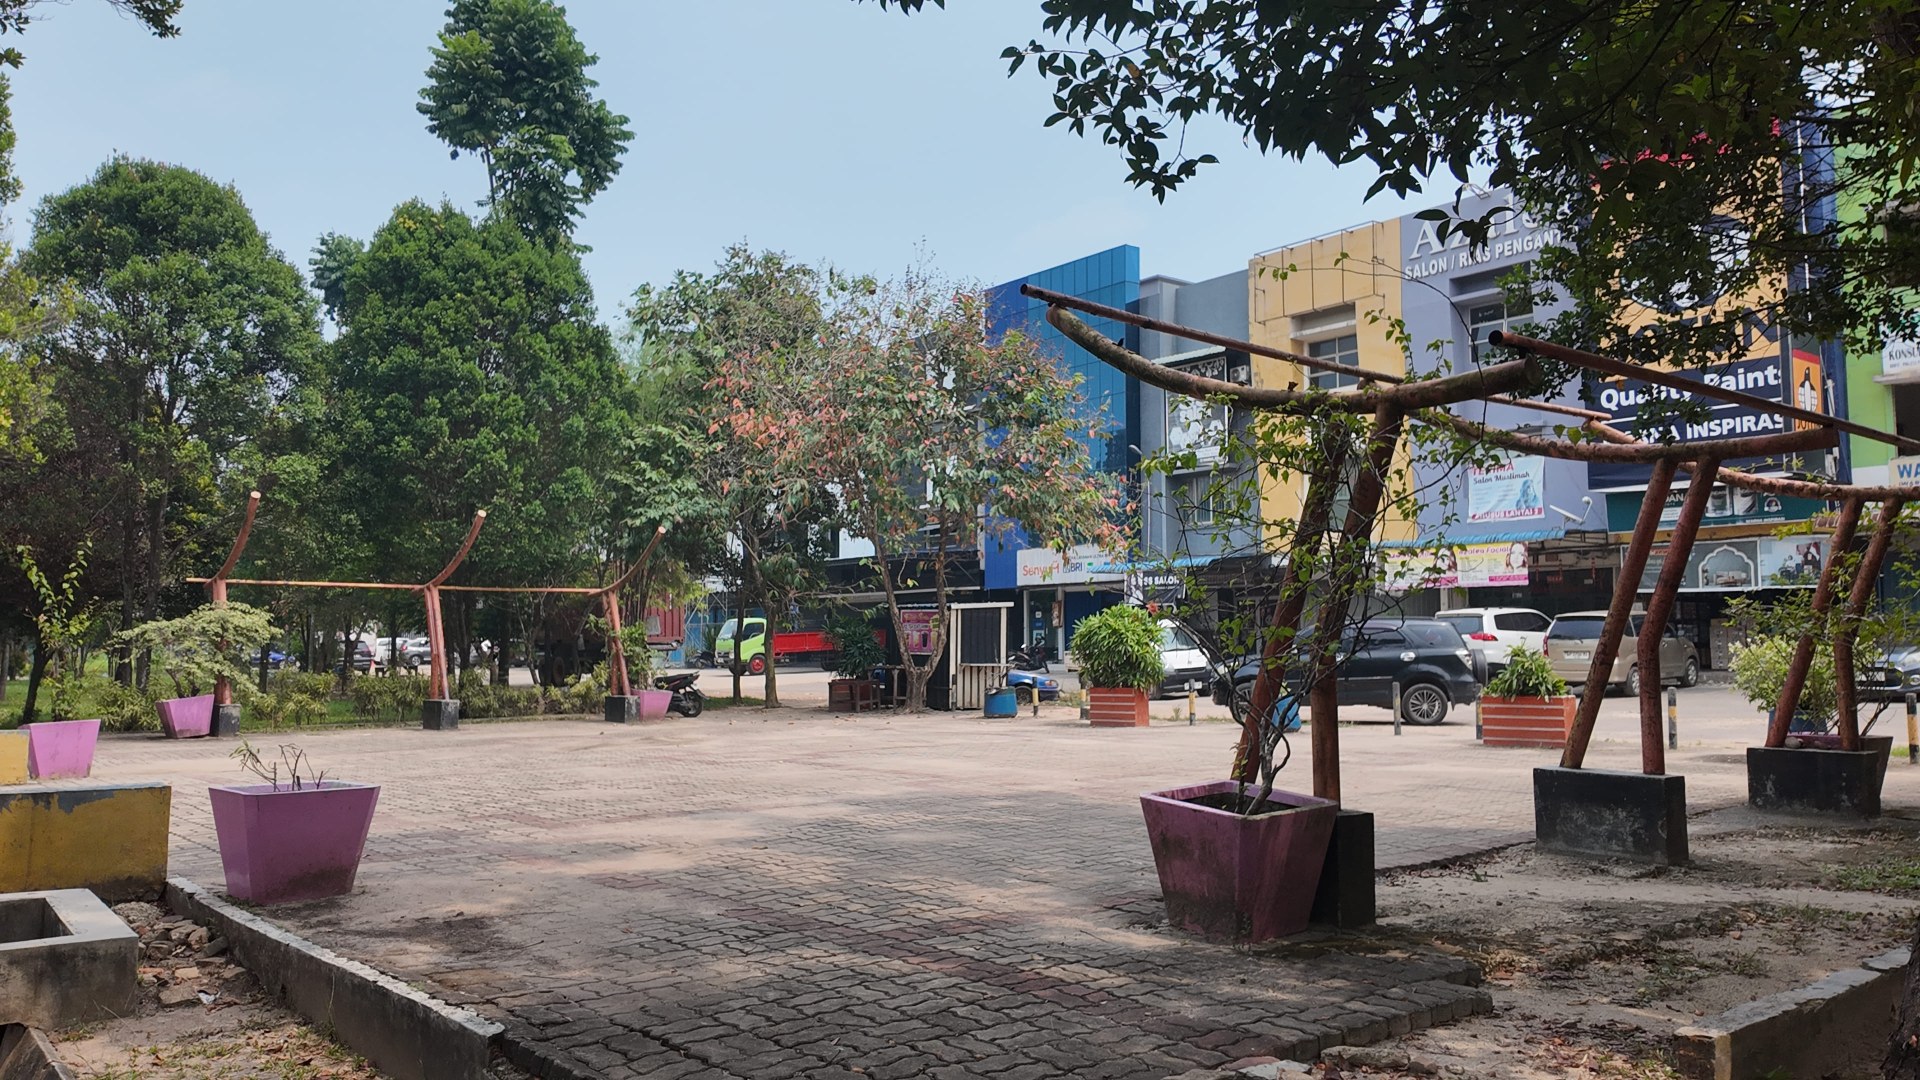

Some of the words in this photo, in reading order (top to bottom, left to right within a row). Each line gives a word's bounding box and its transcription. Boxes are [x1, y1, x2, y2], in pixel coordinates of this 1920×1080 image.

[1404, 256, 1448, 281] SALON
[1472, 476, 1493, 486] Salon
[1495, 471, 1531, 482] Muslimah
